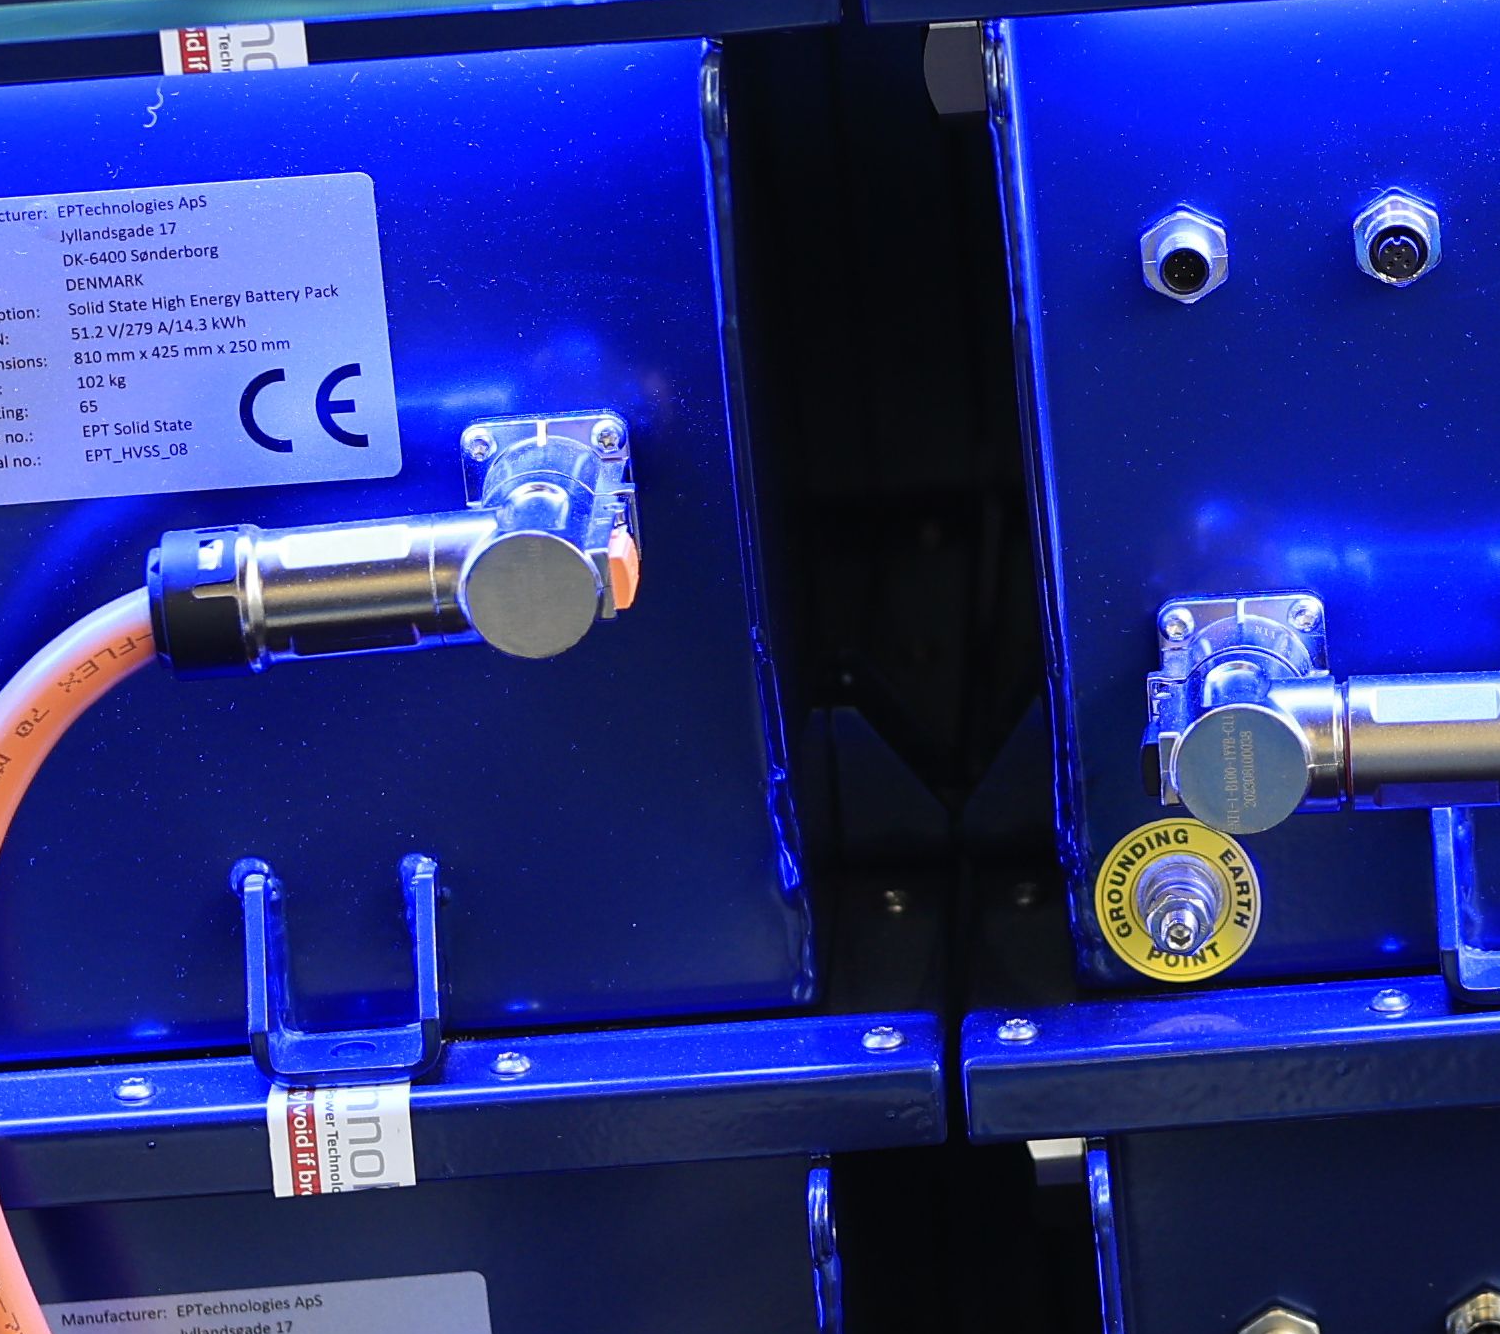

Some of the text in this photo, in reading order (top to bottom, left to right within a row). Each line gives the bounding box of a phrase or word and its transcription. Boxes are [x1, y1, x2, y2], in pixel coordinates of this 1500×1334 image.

[57, 198, 174, 218] EPTechnologies
[178, 195, 207, 211] ApS
[60, 222, 176, 245] Jyllandsgade 17
[63, 245, 219, 267] DK-6400 Sønderborg
[66, 273, 144, 291] DENMARK
[68, 300, 104, 316] Solid
[108, 299, 148, 313] State
[152, 295, 186, 312] High
[190, 294, 241, 308] Energy
[245, 290, 300, 303] Battery
[305, 284, 339, 299] Pack
[71, 325, 104, 340] 51.2
[107, 322, 153, 339] V/279
[157, 318, 207, 336] A/14.3
[211, 315, 246, 330] kWh
[74, 350, 102, 365] 810
[106, 351, 135, 362] mm
[139, 350, 148, 360] x
[151, 345, 179, 359] 425
[184, 345, 213, 357] mm
[216, 344, 226, 354] x
[229, 339, 257, 354] 250
[261, 340, 290, 351] mm
[77, 375, 105, 389] 102
[109, 373, 126, 389] kg
[79, 400, 98, 413] 65
[5, 432, 33, 444] no.:
[83, 423, 109, 438] EPT
[114, 420, 150, 436] Solid
[154, 419, 192, 433] State
[13, 456, 41, 467] no.:
[85, 442, 188, 464] EPT_HVSS_08
[1107, 828, 1189, 939] GROUNDING
[1219, 848, 1252, 929] EARTH
[1147, 941, 1222, 968] POINT
[291, 1104, 314, 1149] void
[61, 1294, 323, 1326] Manufacturer: EPTechnologies ApS
[276, 1320, 293, 1334] 17
